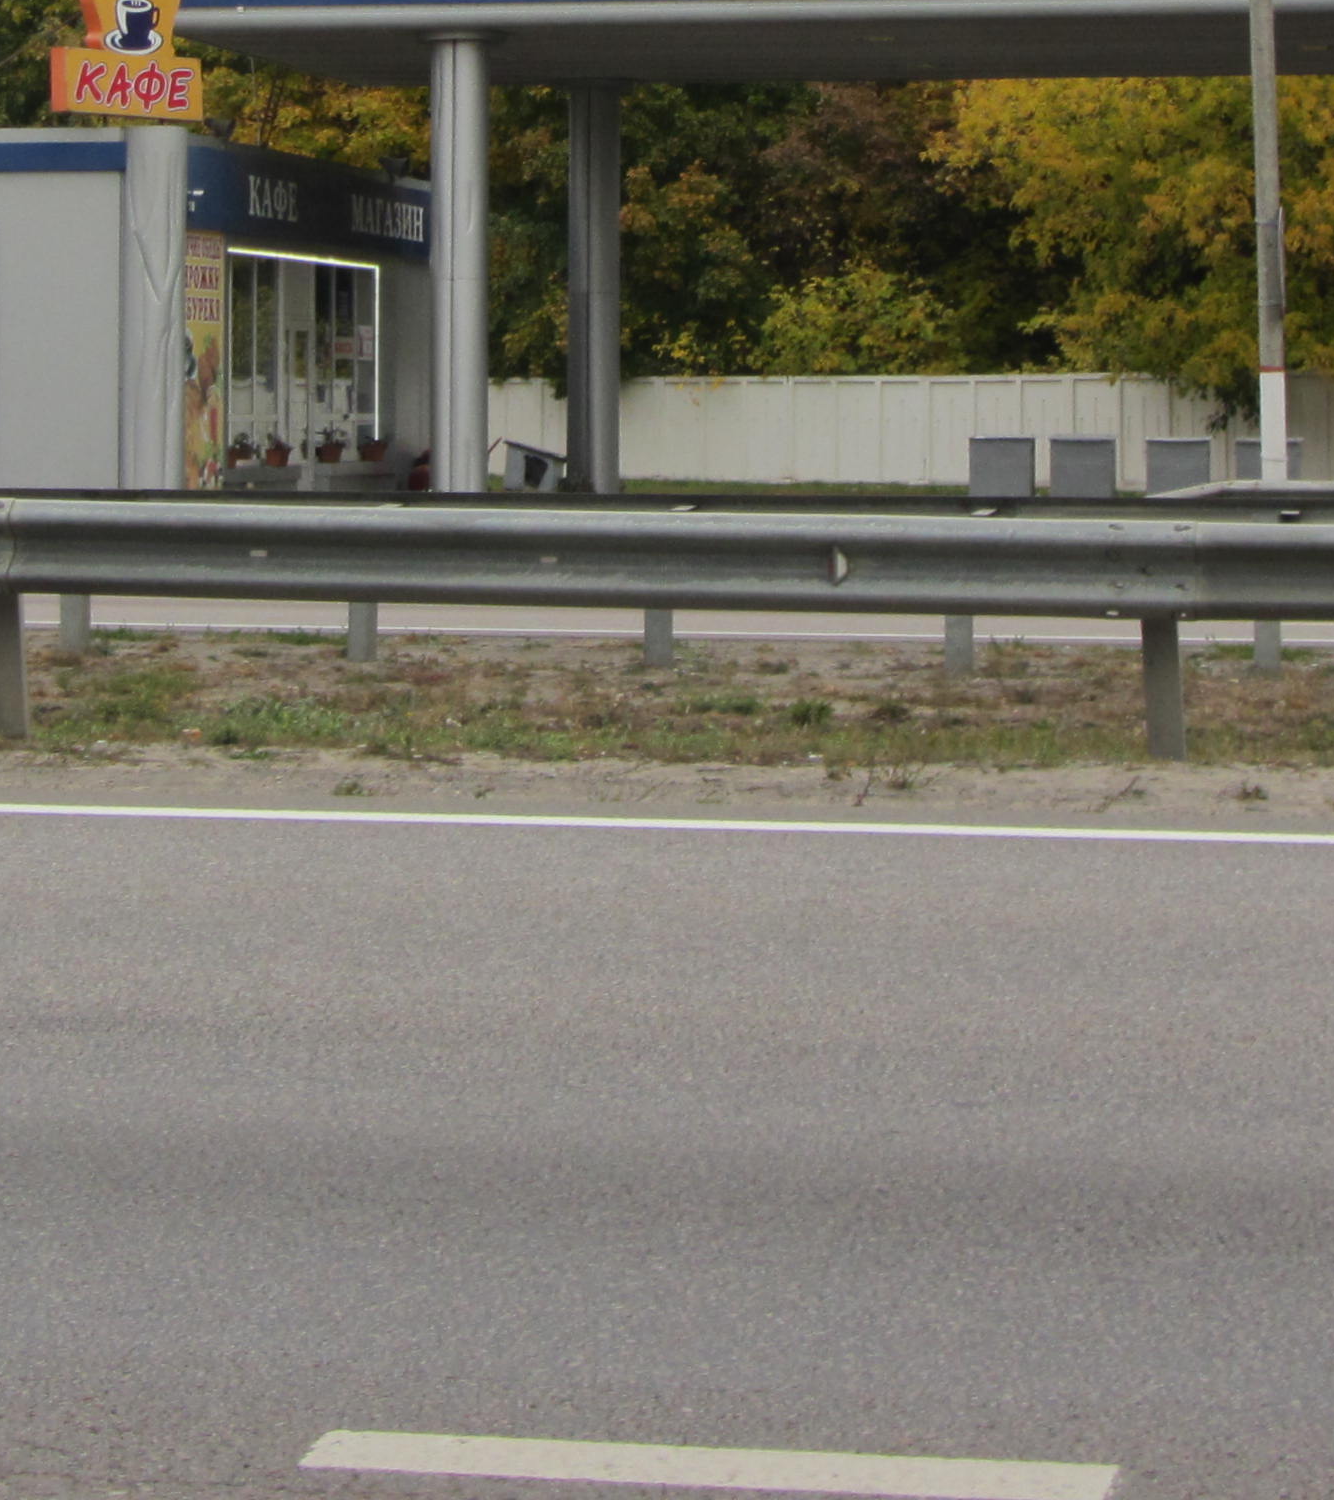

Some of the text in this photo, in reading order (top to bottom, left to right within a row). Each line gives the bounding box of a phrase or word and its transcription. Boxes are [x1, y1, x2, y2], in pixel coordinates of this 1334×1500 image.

[75, 60, 194, 113] КАФЕ
[248, 175, 299, 223] КАФЕ
[351, 193, 424, 243] МАГАЗИН
